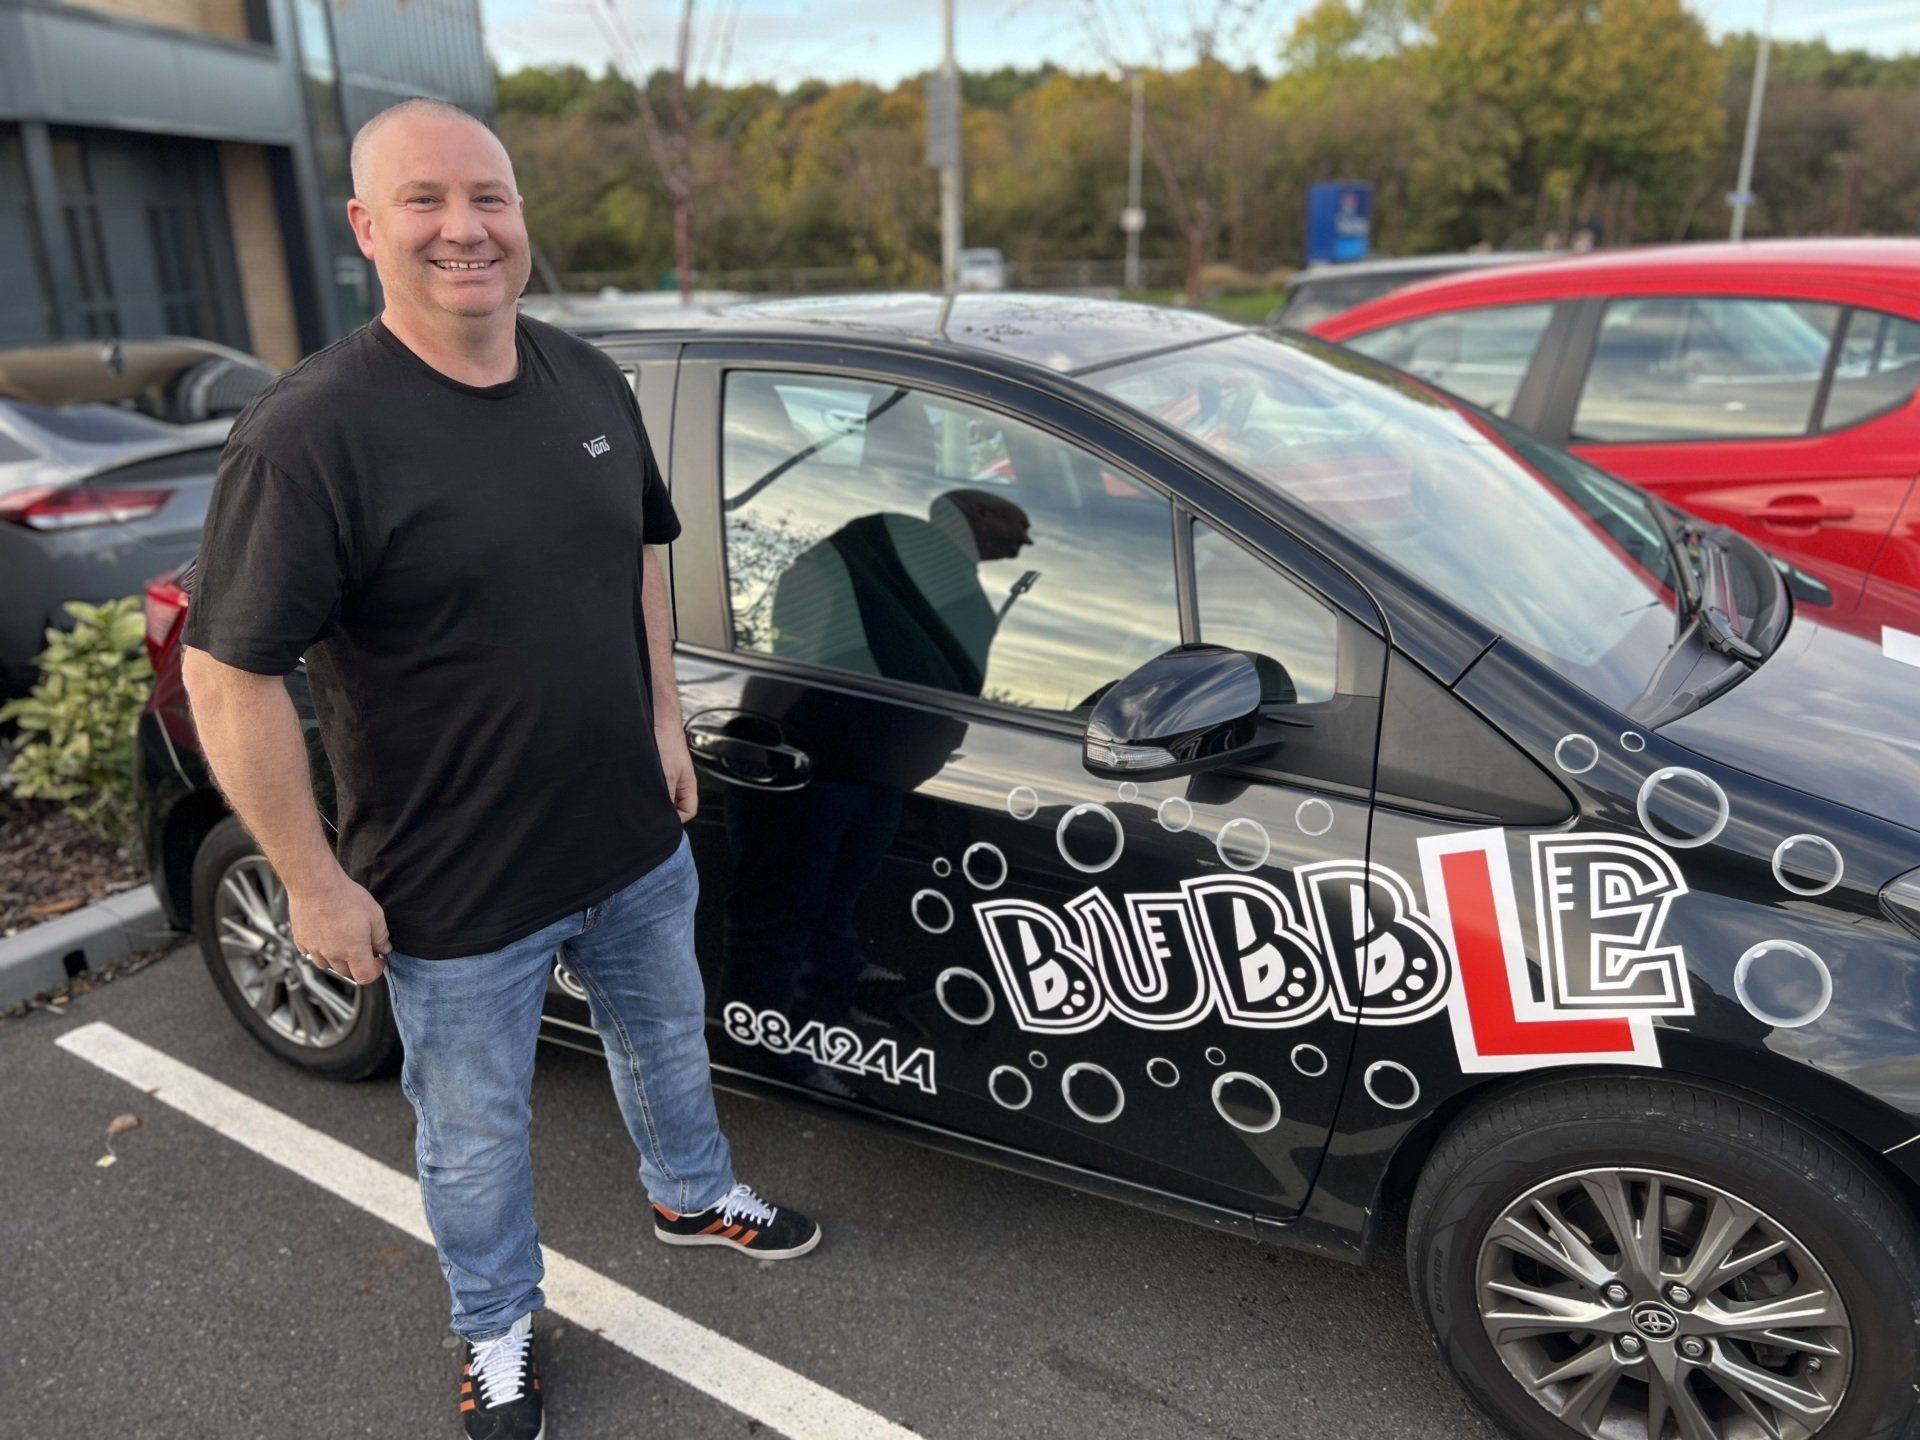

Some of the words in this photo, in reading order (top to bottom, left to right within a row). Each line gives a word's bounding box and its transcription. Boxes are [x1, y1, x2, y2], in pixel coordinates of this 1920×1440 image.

[582, 435, 611, 458] Vans
[972, 828, 1696, 1074] BUBBLE
[722, 1001, 938, 1095] 884244
